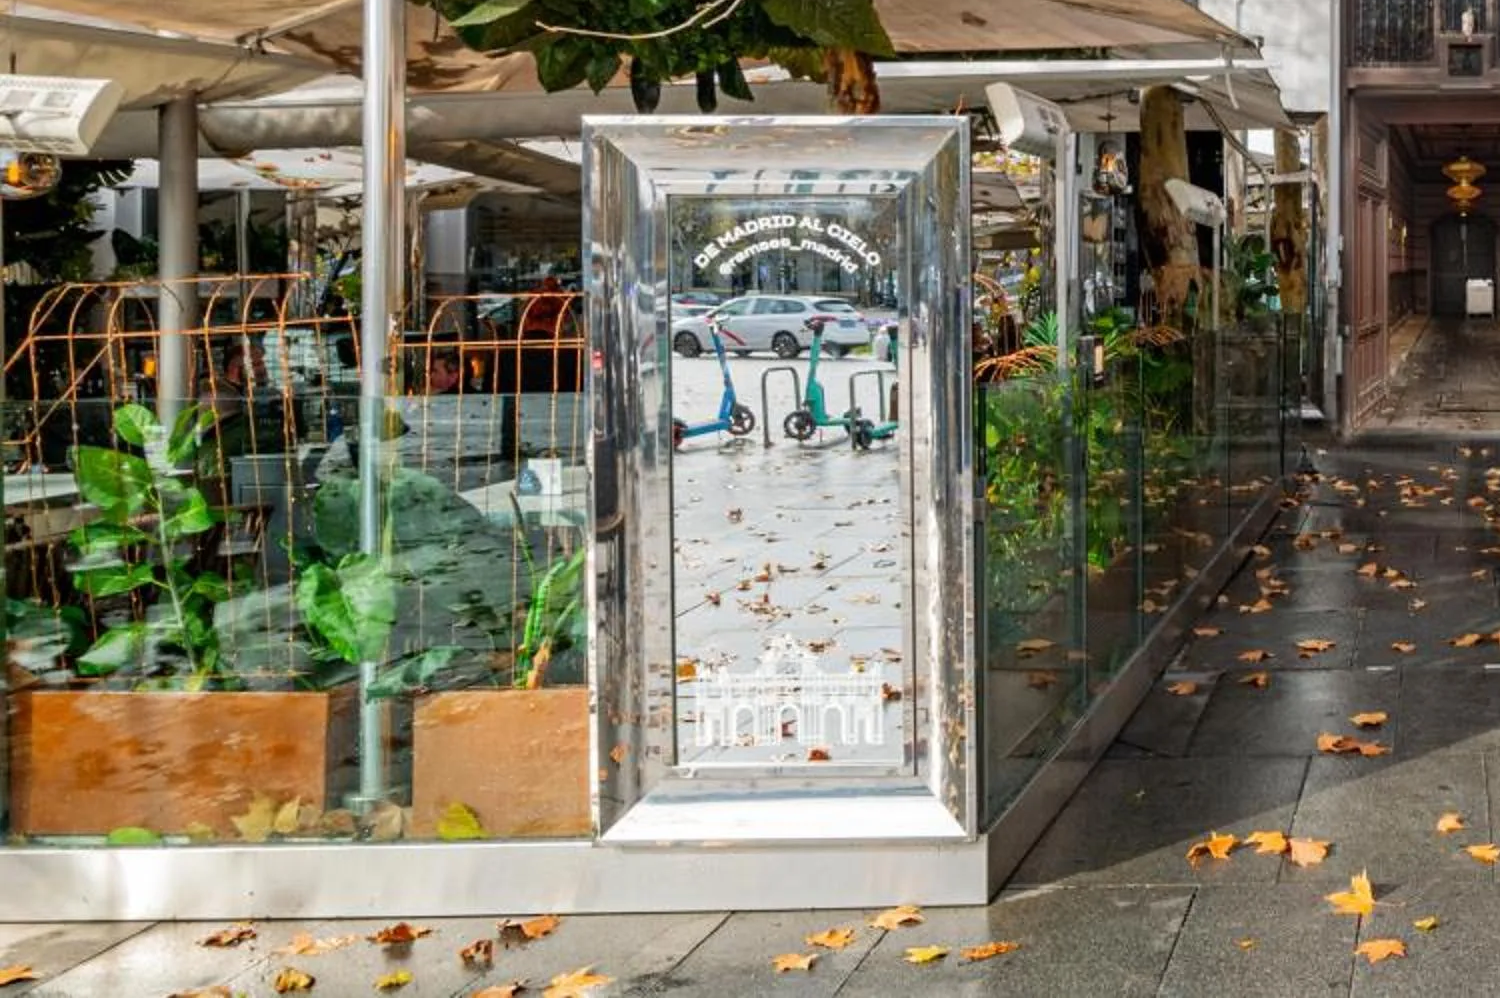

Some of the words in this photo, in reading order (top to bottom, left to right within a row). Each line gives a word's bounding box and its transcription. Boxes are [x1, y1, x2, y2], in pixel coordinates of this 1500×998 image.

[693, 242, 721, 269] DE
[716, 215, 796, 249] MADRID
[798, 215, 825, 233] AL
[826, 224, 881, 266] CIELO
